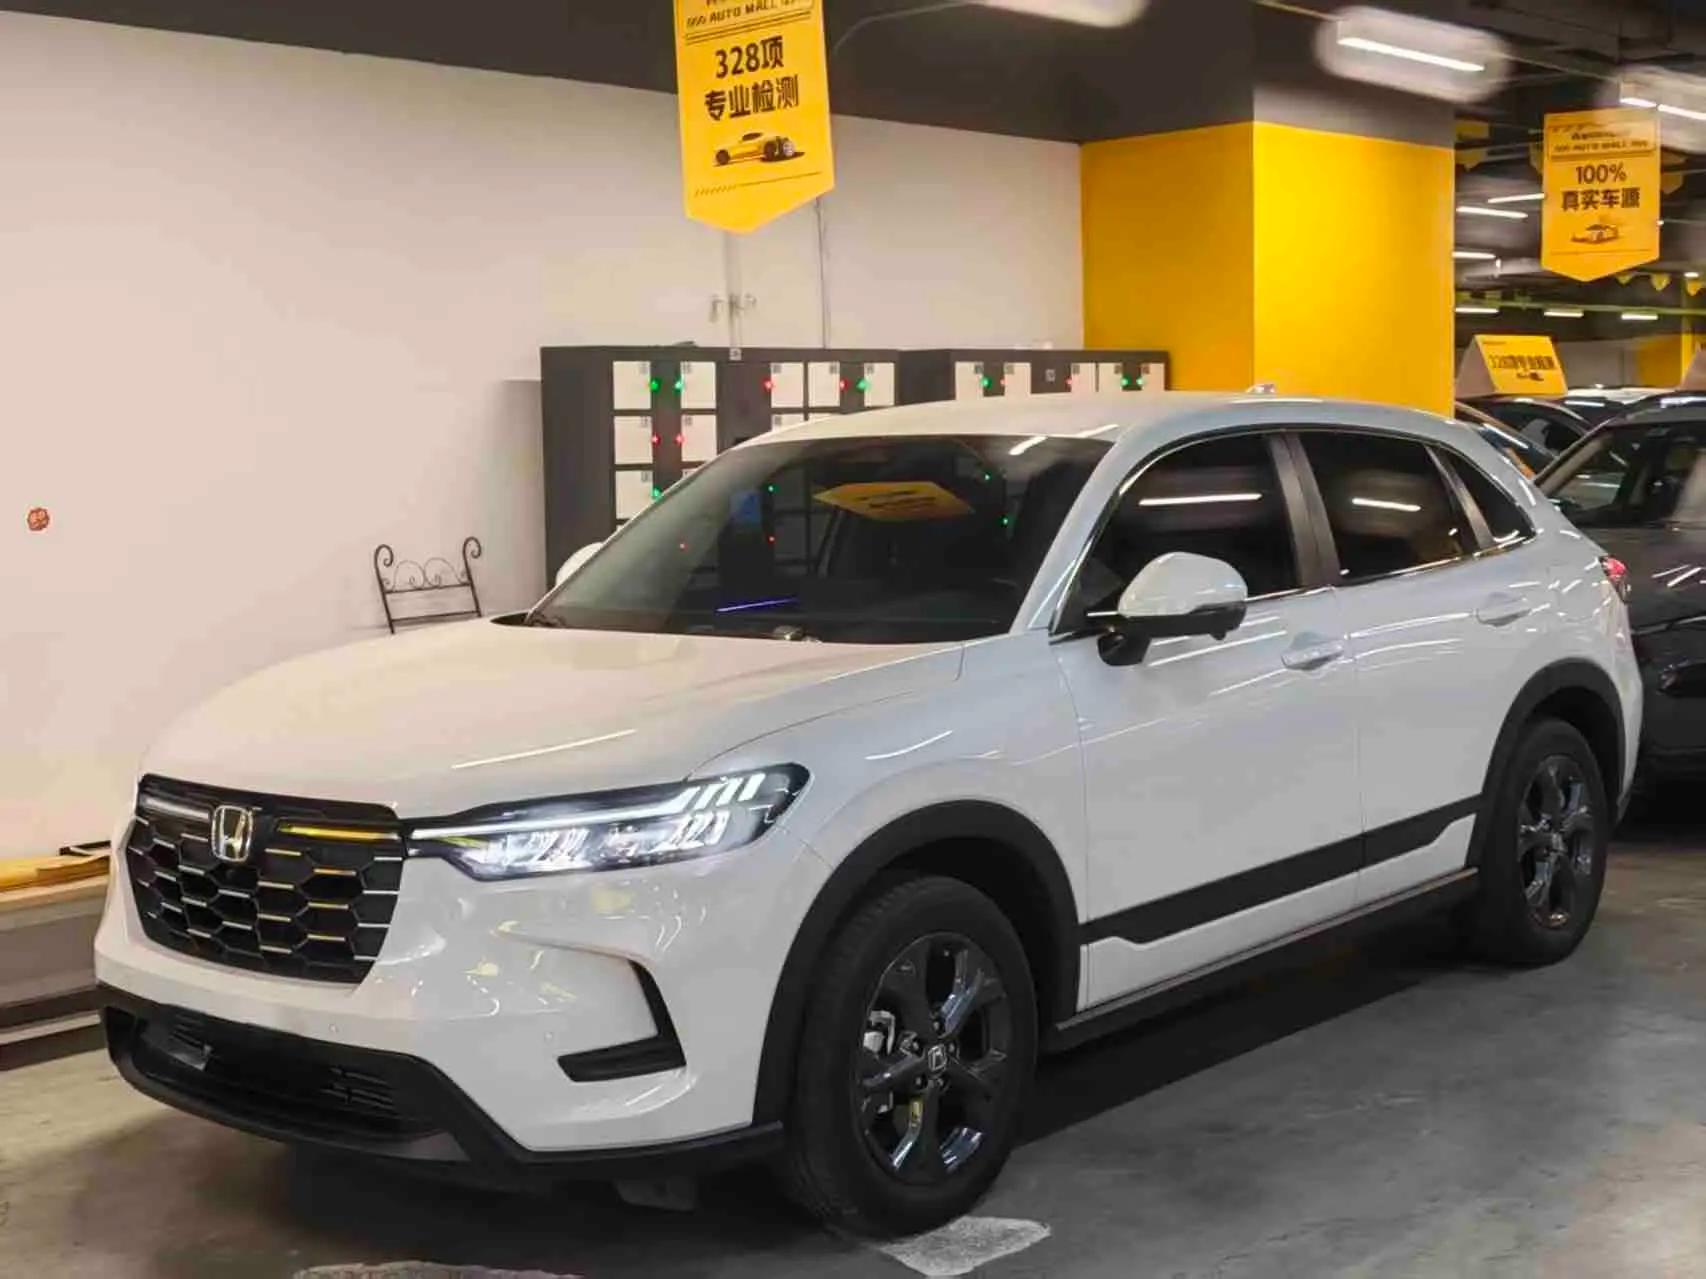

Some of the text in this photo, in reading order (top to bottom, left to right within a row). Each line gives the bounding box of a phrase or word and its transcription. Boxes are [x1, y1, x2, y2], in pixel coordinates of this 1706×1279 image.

[710, 7, 741, 24] AUTO
[715, 35, 784, 78] 328项
[704, 74, 799, 121] 专业检测
[1576, 161, 1627, 184] 100%
[1561, 187, 1641, 212] 真实车源
